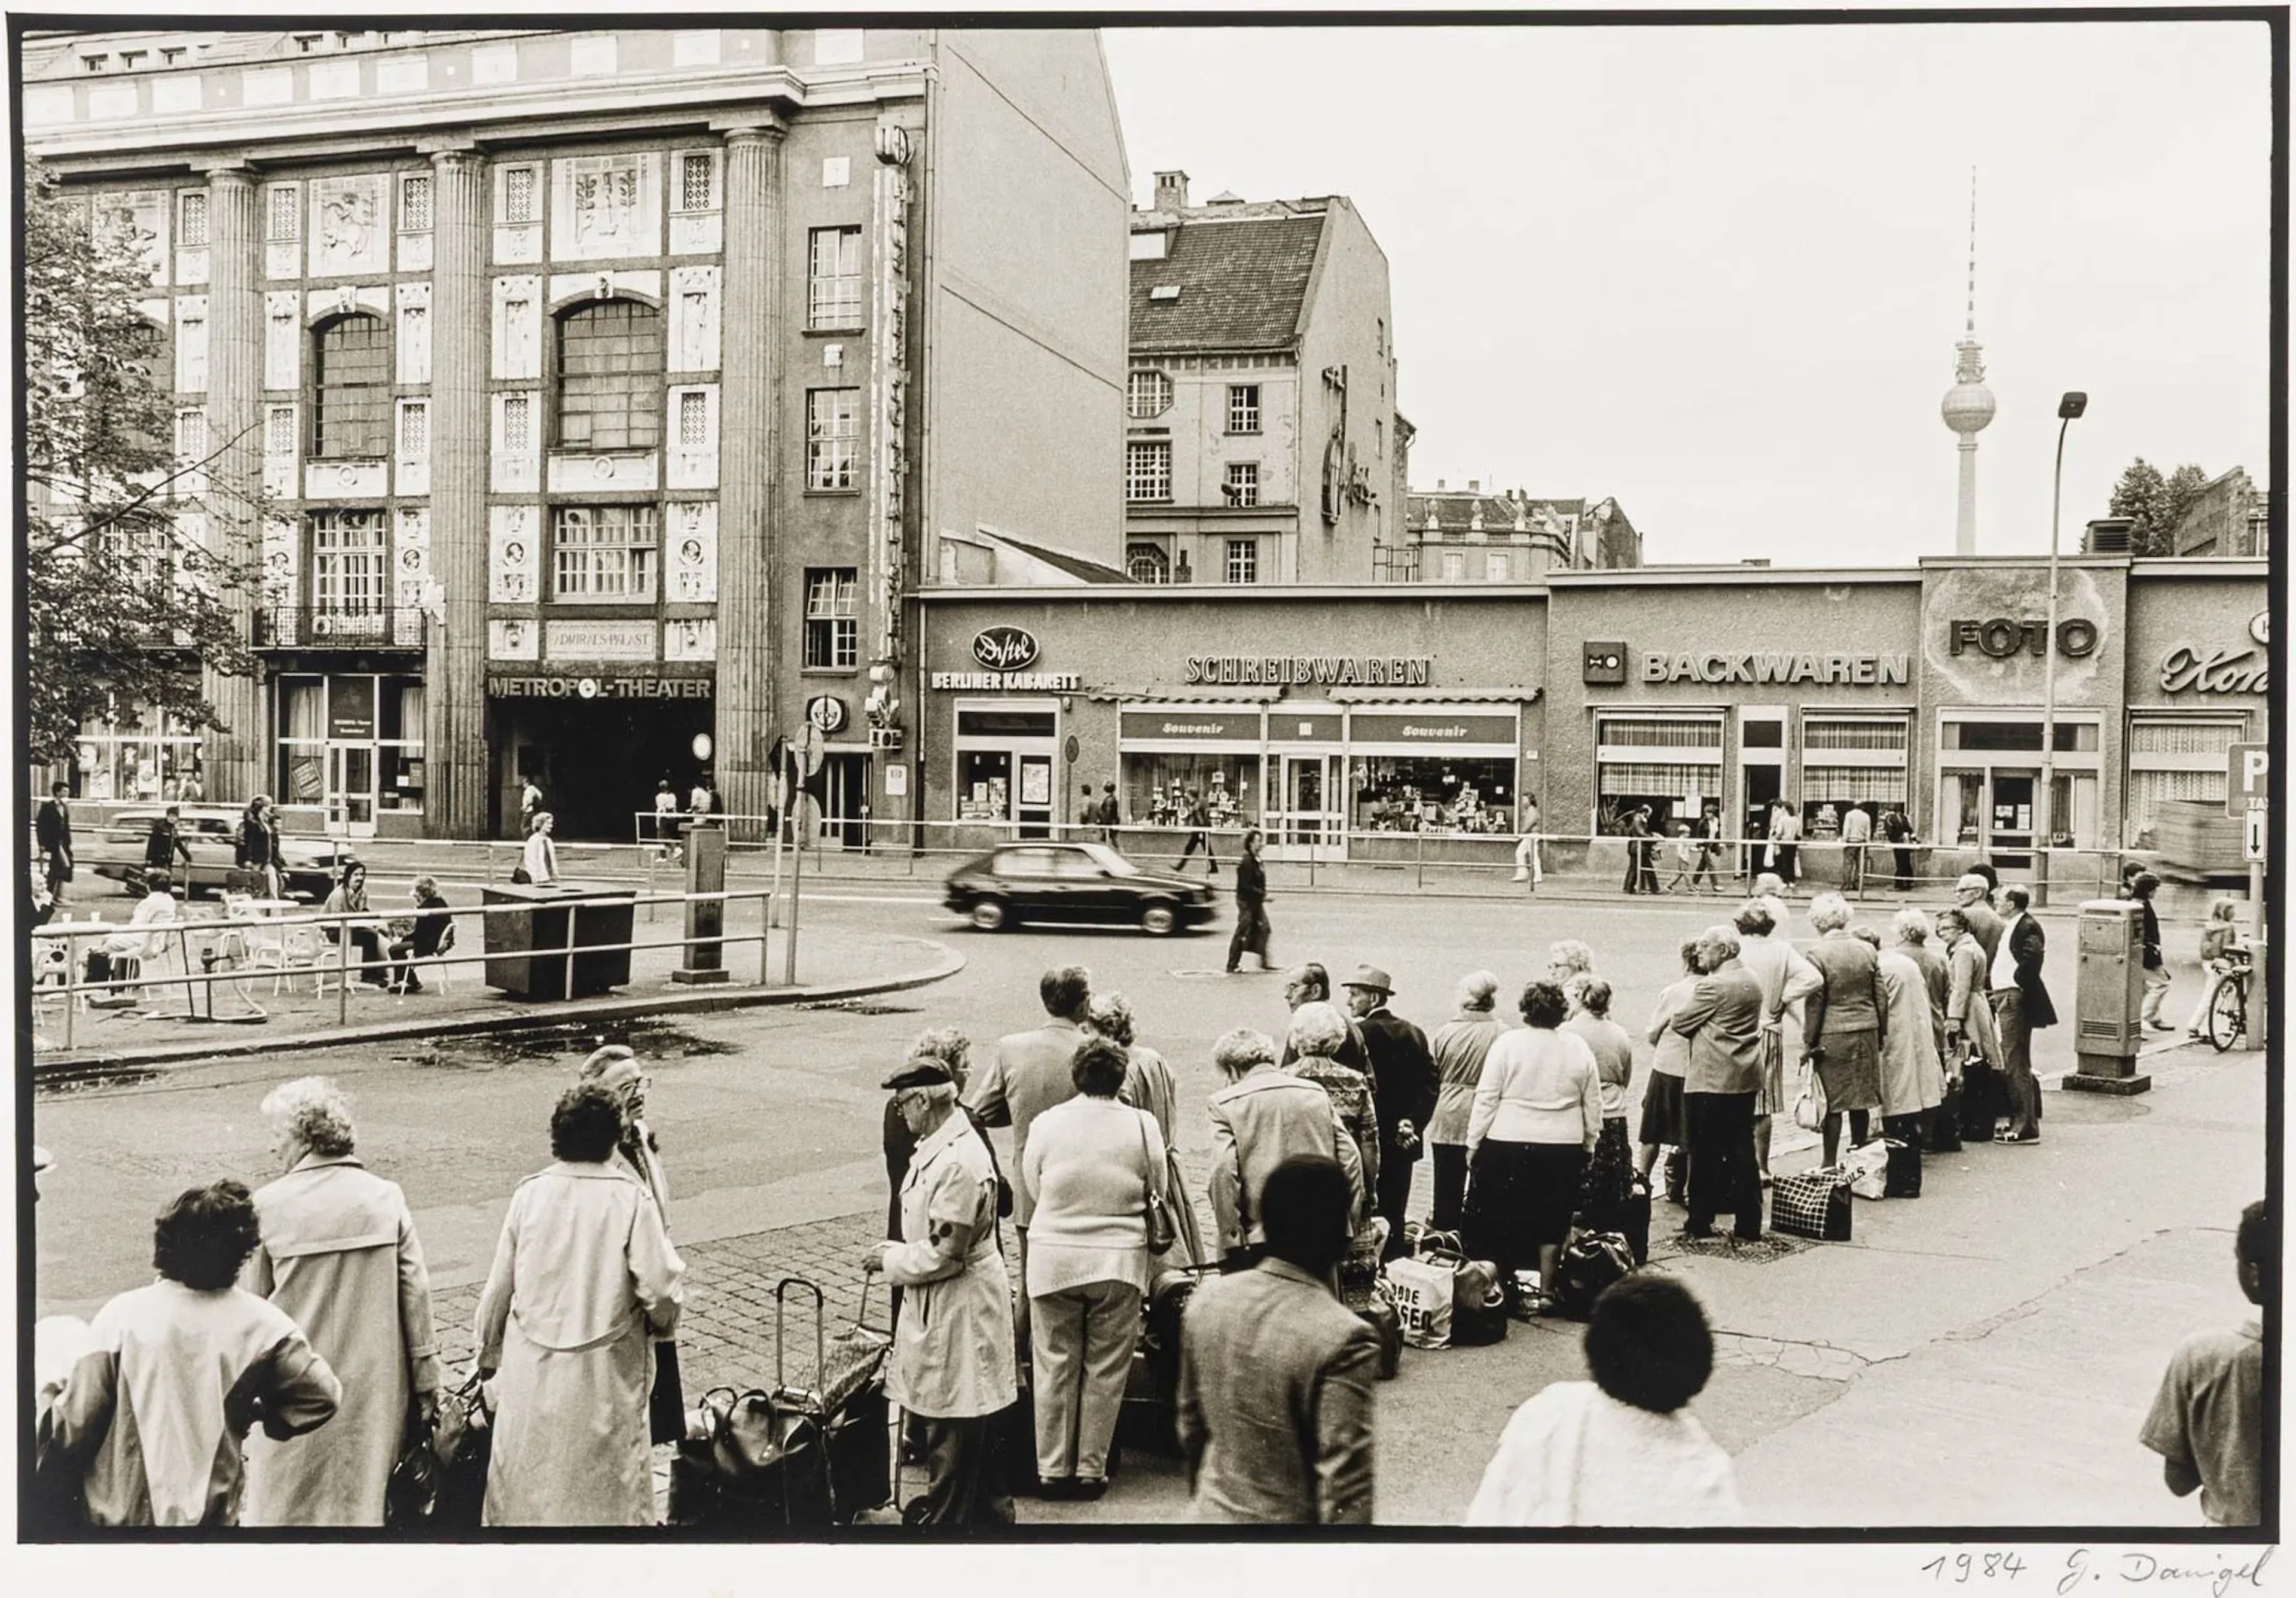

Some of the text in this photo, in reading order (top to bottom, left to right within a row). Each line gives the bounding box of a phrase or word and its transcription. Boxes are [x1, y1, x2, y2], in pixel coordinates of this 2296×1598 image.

[976, 633, 1031, 667] Distel
[1950, 618, 2097, 656] FOTO
[932, 672, 1081, 689] BERLINER KABARETT
[1185, 657, 1430, 685] SCHREIBWAREN
[1642, 654, 1909, 684] BACKWAREN
[488, 678, 711, 698] METROPOL-THEATER
[1162, 722, 1223, 734] Souvenir
[1402, 725, 1467, 737] Souvenir
[2243, 751, 2268, 791] P
[1922, 1552, 2028, 1582] 1984
